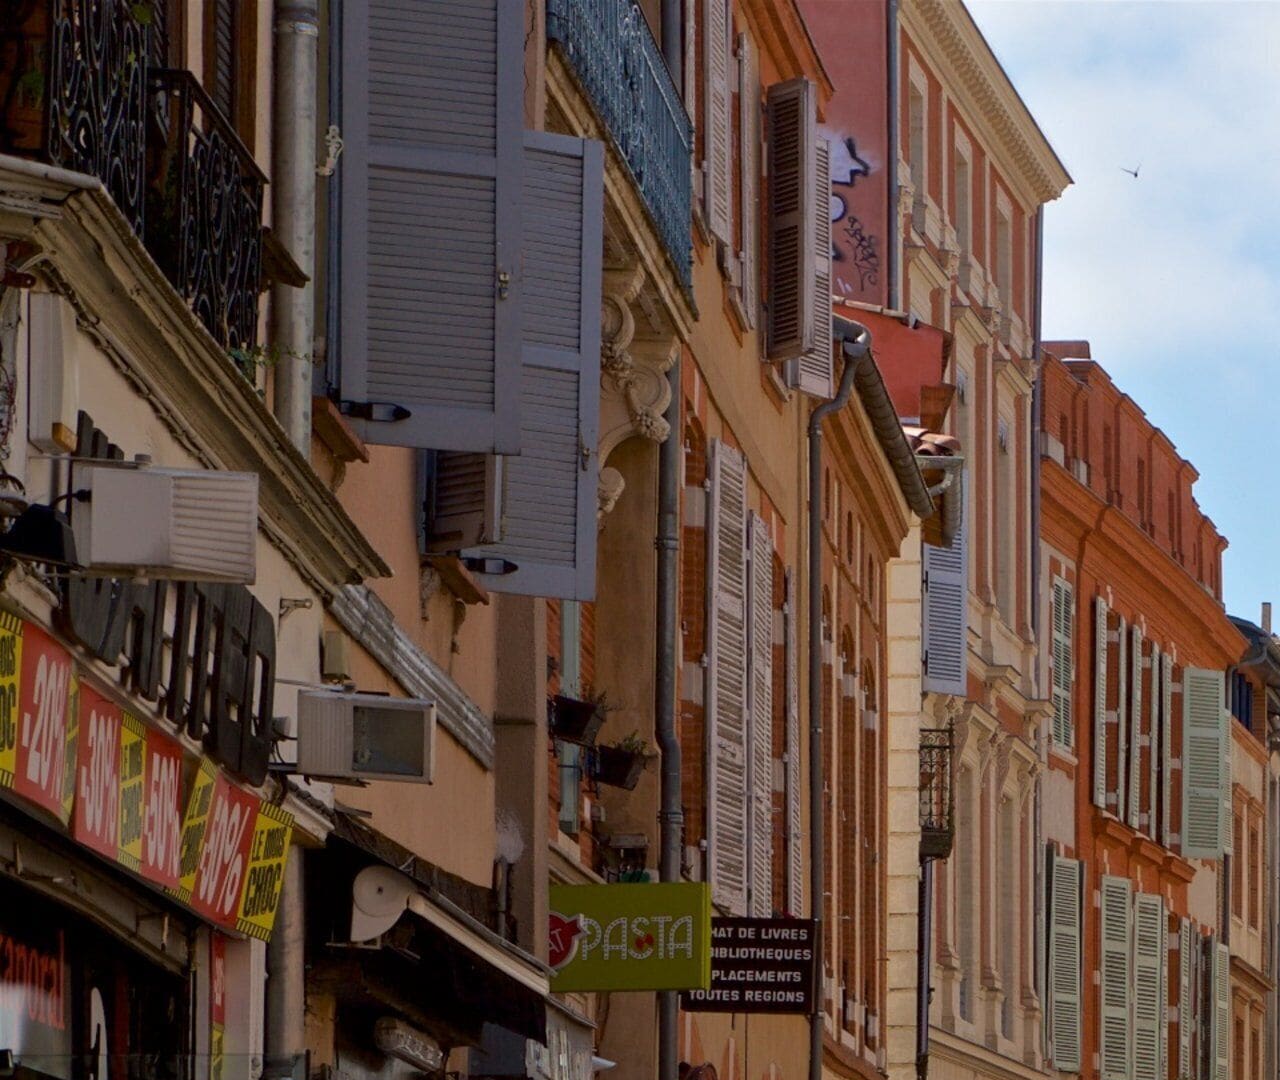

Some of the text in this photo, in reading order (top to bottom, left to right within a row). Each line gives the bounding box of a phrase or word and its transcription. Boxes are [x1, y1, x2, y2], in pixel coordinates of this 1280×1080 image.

[22, 653, 70, 801] -20%
[81, 709, 118, 847] -30%
[144, 752, 181, 878] -50%
[252, 829, 266, 862] LE
[243, 862, 282, 918] CHOC
[582, 915, 693, 961] PASTA
[738, 927, 755, 939] DE
[761, 928, 808, 940] LIVRES
[709, 947, 812, 960] BIBLIOTHEQUES
[711, 969, 801, 982] PLACEMENTS
[689, 990, 805, 1002] TOUTES REGIONS
